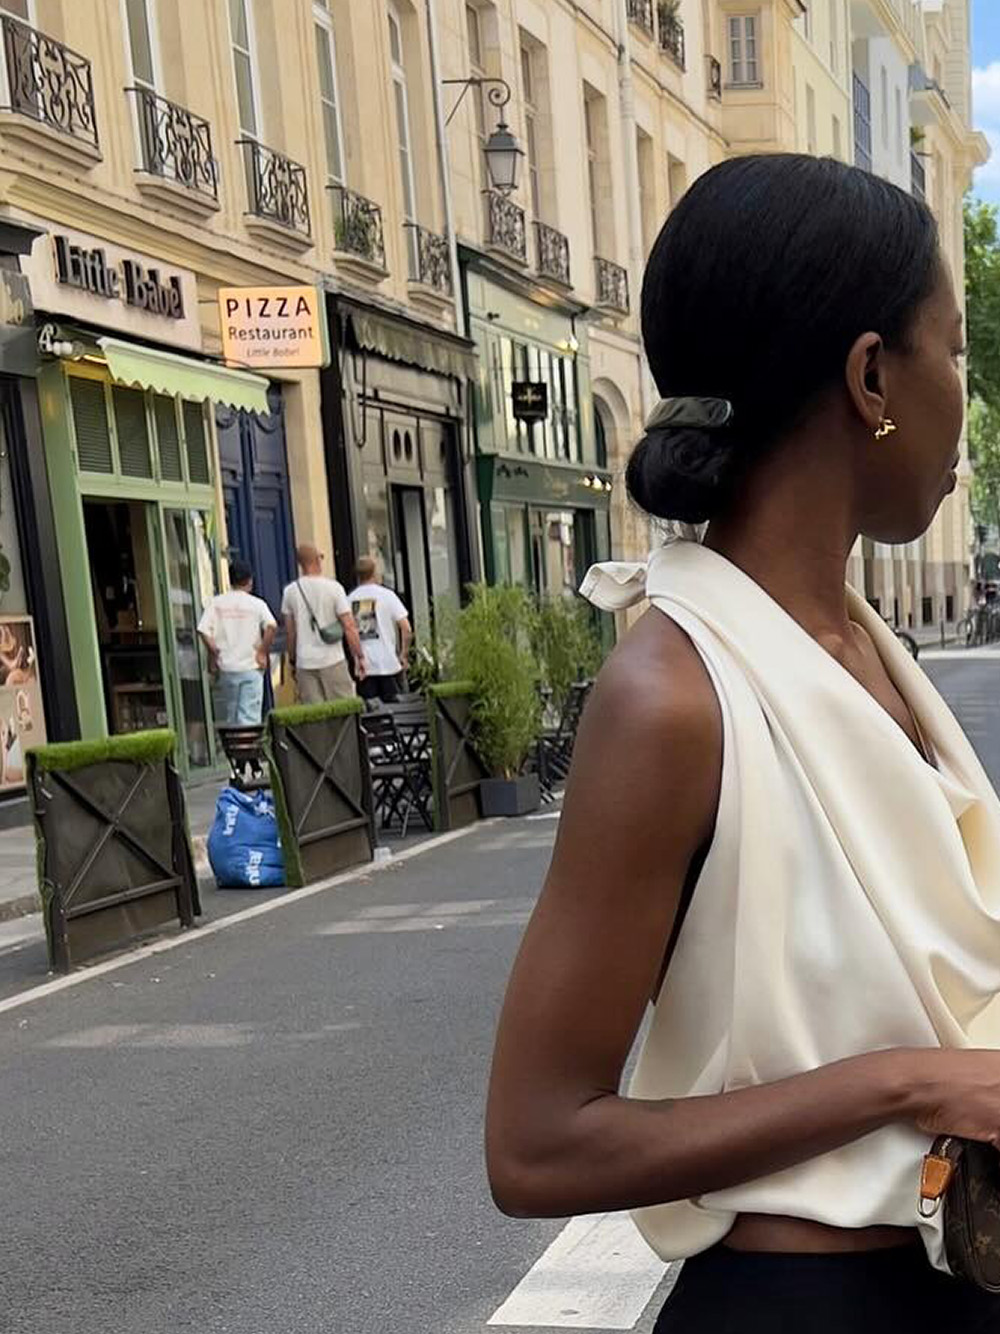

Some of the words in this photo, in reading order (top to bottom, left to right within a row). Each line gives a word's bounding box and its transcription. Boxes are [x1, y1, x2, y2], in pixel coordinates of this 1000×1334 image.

[54, 235, 119, 299] Little
[121, 259, 186, 320] Babel
[226, 296, 312, 318] PIZZA
[228, 326, 315, 341] Restaurant
